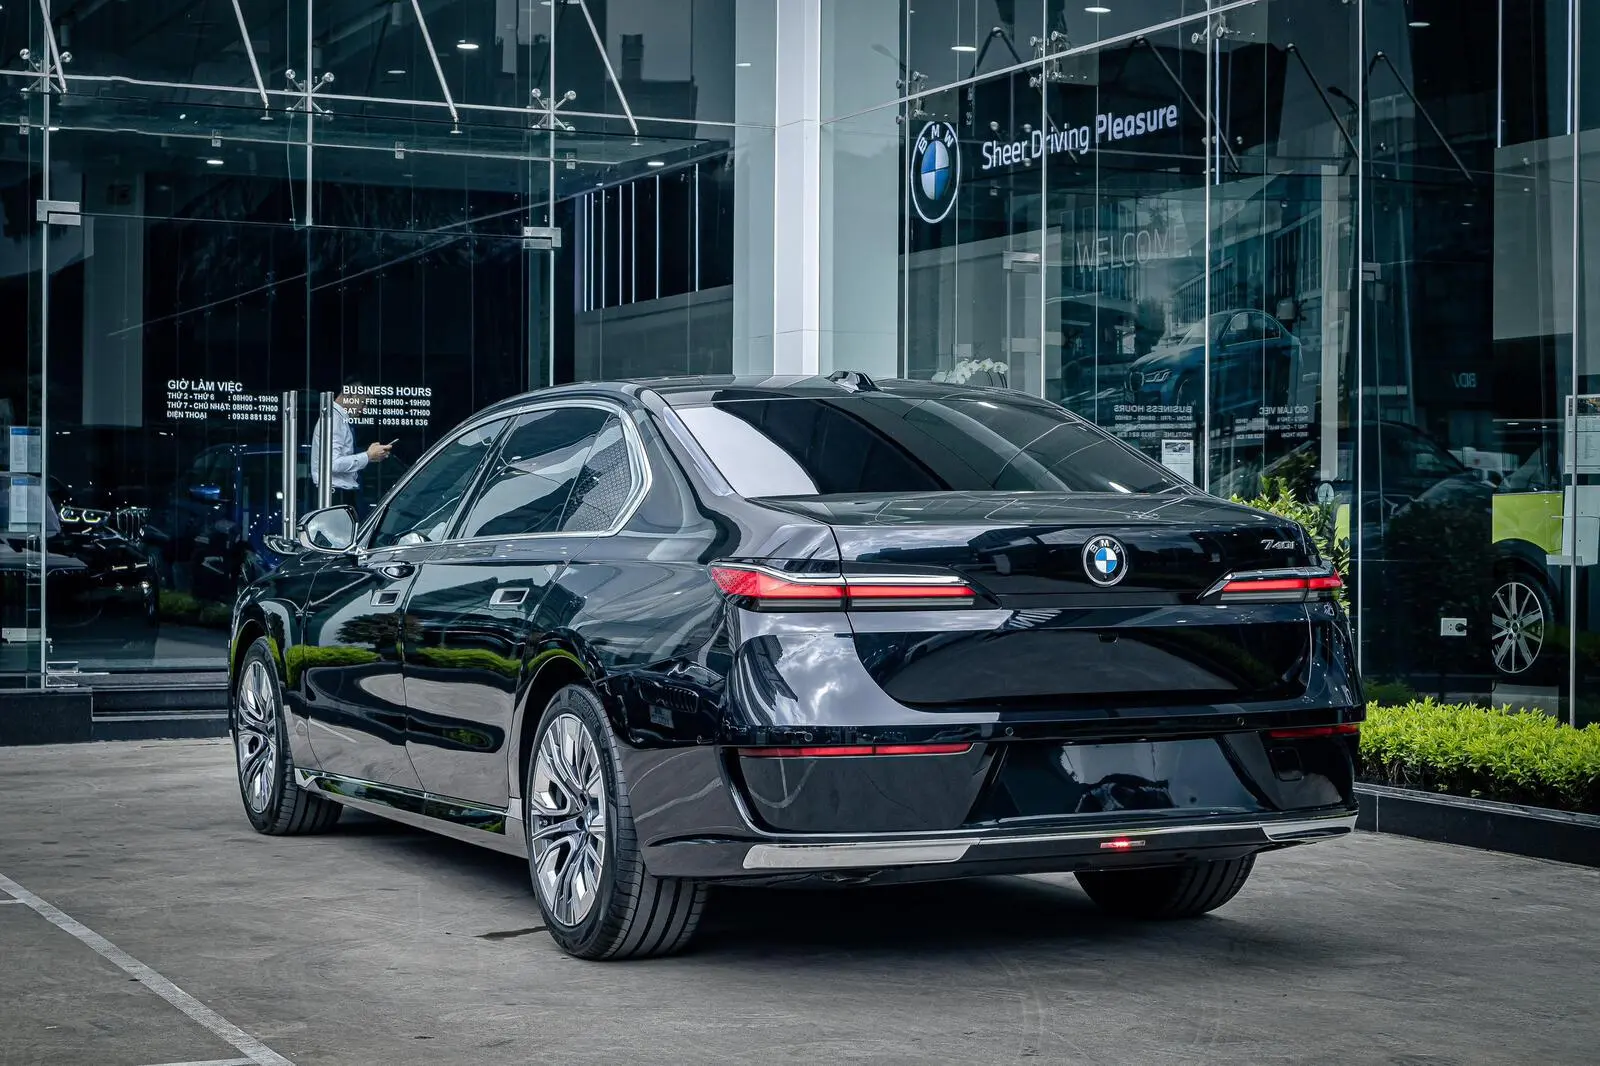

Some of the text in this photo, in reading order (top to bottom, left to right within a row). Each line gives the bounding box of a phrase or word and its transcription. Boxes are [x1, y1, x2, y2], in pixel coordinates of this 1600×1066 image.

[918, 123, 954, 155] BMW
[982, 104, 1178, 170] Sheer Driving Pleasure
[167, 378, 243, 394] GIỜ LÀM VIỆC
[342, 385, 432, 397] BUSINESS HOURS
[183, 392, 189, 400] 2
[232, 394, 253, 402] 08H00
[258, 395, 279, 403] 19H00
[342, 397, 360, 405] MON
[382, 398, 404, 406] 08H00
[409, 399, 431, 407] 19H00
[232, 403, 253, 411] 08H00
[258, 404, 279, 412] 17H00
[343, 407, 357, 415] SAT
[362, 407, 378, 415] SUN
[184, 411, 207, 420] THOẠI
[342, 417, 374, 425] HOTLINE
[1089, 539, 1121, 554] BMW
[1260, 539, 1296, 550] 740i
